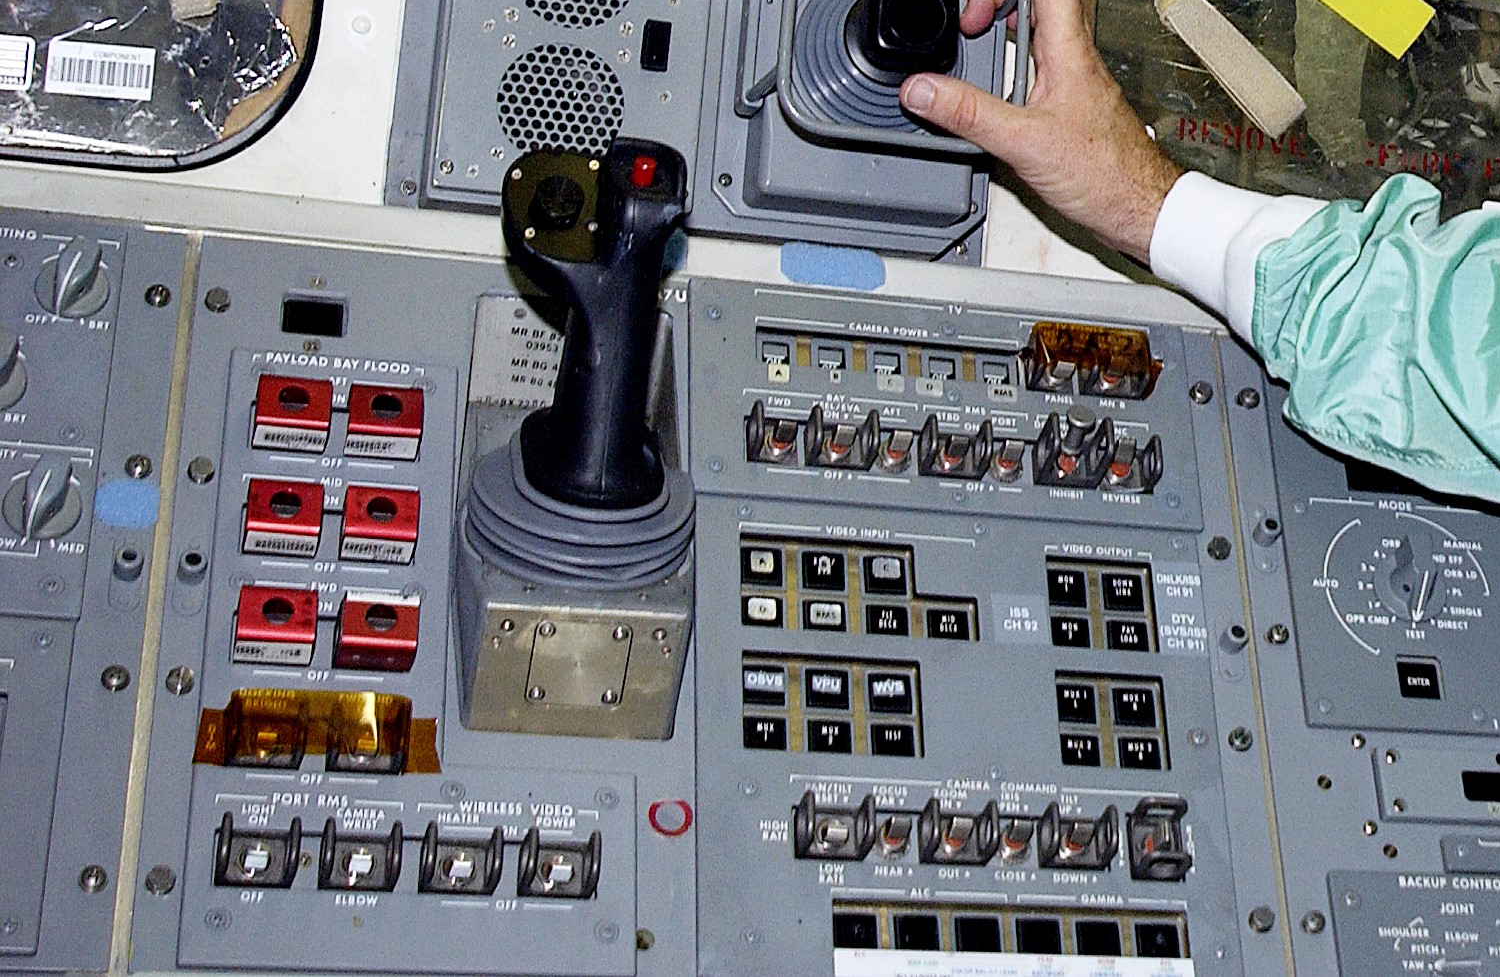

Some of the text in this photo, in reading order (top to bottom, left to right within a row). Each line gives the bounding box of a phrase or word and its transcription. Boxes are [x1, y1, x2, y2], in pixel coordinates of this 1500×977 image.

[948, 304, 963, 315] TV
[25, 315, 47, 325] OFF
[89, 321, 110, 331] BRT
[511, 326, 529, 338] MR
[849, 322, 929, 339] CAMERA POWER
[265, 352, 411, 375] PAYLOAD BAY FLOOD
[511, 358, 528, 369] MR
[329, 376, 348, 388] AFT
[767, 396, 792, 407] FWD
[1045, 395, 1074, 405] PANEL
[1100, 401, 1116, 410] MN
[823, 412, 842, 421] ON
[882, 407, 901, 417] AFT
[936, 412, 961, 422] STBD
[965, 406, 987, 416] RMS
[4, 413, 27, 425] BRT
[991, 417, 1017, 428] PORT
[963, 423, 980, 432] ON
[321, 458, 344, 469] OFF
[824, 471, 844, 480] OFF
[319, 476, 344, 488] MID
[966, 483, 986, 493] OFF
[1050, 489, 1085, 501] INHIBIT
[1102, 493, 1141, 505] REVERSE
[1378, 499, 1412, 512] MODE
[825, 525, 891, 540] VIDEO INPUT
[58, 543, 85, 555] MED
[1381, 538, 1401, 548] ORB
[1443, 539, 1483, 552] MANUAL
[1062, 543, 1133, 558] VIDEO OUTPUT
[314, 563, 337, 574] OFF
[1156, 573, 1201, 586] DNLK/ISS
[1312, 577, 1340, 589] AUTO
[310, 582, 338, 593] FWD
[1166, 586, 1181, 597] CH
[1009, 607, 1030, 618] ISS
[1449, 607, 1483, 618] SINGLE
[1003, 619, 1023, 631] CH
[1171, 613, 1196, 625] DTV
[1367, 615, 1390, 626] CMD
[1437, 620, 1469, 631] DIRECT
[1405, 629, 1426, 640] TEST
[1168, 638, 1185, 649] CH
[306, 671, 330, 682] OFF
[1407, 676, 1431, 688] ENTER
[811, 674, 842, 692] VPU
[872, 679, 906, 695] WVS
[299, 774, 324, 786] OFF
[872, 785, 908, 798] FOCUS
[946, 779, 1058, 795] CAMERA COMMAND
[932, 787, 968, 800] ZOOM
[1000, 792, 1021, 803] IRIS
[1060, 794, 1080, 805] TILT
[272, 793, 350, 809] PORT RMS
[874, 796, 897, 807] FAR
[939, 799, 955, 809] IN
[241, 803, 277, 816] LIGHT
[336, 808, 386, 821] CAMERA
[459, 800, 574, 818] WIRELESS VIDEO
[248, 814, 270, 826] ON
[437, 812, 481, 824] HEATER
[536, 817, 577, 828] POWER
[343, 819, 379, 831] WRIST
[760, 820, 789, 831] HIGH
[762, 830, 789, 842] RATE
[818, 863, 845, 874] LOW
[874, 865, 905, 877] NEAR
[937, 867, 960, 879] OUT
[818, 873, 845, 885] RATE
[994, 871, 1026, 883] CLOSE
[1053, 872, 1088, 885] DOWN
[1398, 875, 1448, 890] BACKUP
[240, 891, 265, 904] OFF
[909, 887, 931, 899] ALC
[335, 895, 380, 907] ELBOW
[495, 900, 519, 911] OFF
[1081, 893, 1125, 906] GAMMA
[1439, 903, 1476, 915] JOINT
[1378, 926, 1430, 938] SHOULDER
[1444, 931, 1480, 943] ELBOW
[1410, 944, 1440, 956] PITCH
[1402, 959, 1425, 971] YAW
